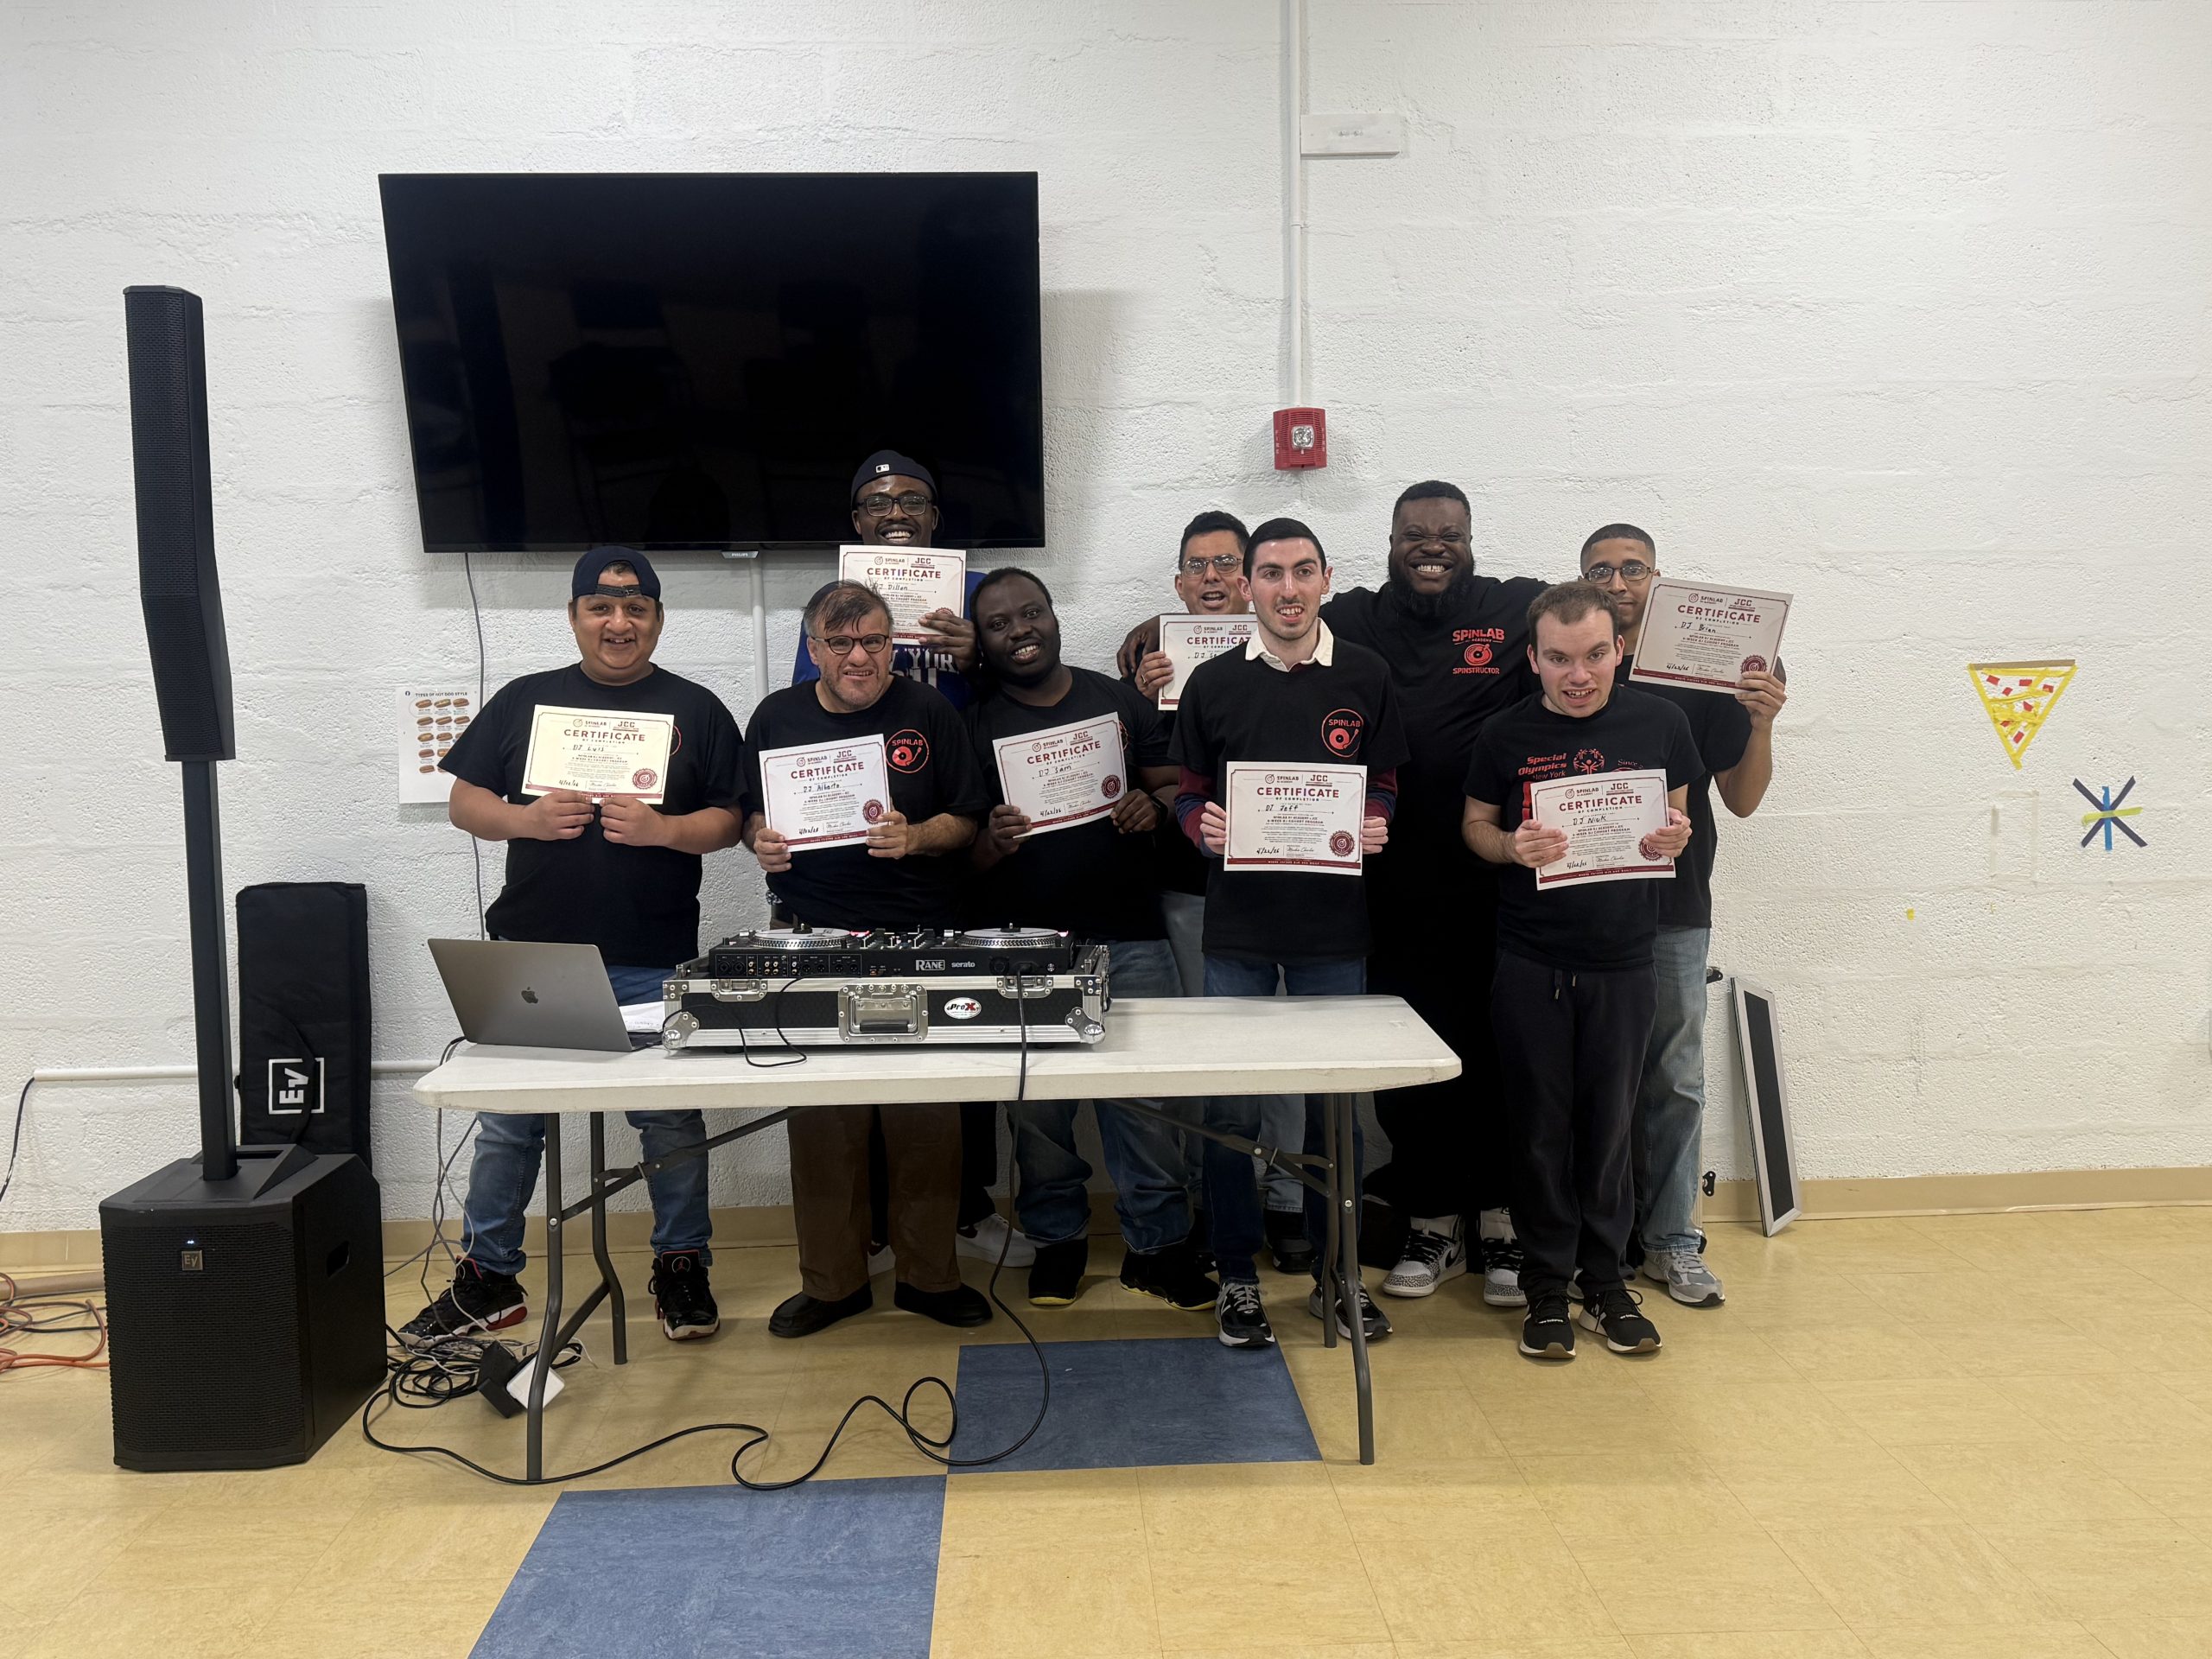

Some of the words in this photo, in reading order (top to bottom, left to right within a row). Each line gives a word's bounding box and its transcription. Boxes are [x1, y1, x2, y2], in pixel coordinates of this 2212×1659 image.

[867, 568, 941, 579] CERTIFICATE
[1734, 598, 1752, 607] JCC
[1677, 605, 1761, 623] CERTIFICATE
[1452, 628, 1505, 642] SPINLAB
[1328, 719, 1361, 728] SPINLAB
[563, 728, 645, 741] CERTIFICATE
[1073, 730, 1089, 740] JCC
[892, 738, 924, 747] SPINLAB
[1027, 741, 1101, 765] CERTIFICATE
[1527, 753, 1567, 765] Special
[791, 761, 864, 779] CERTIFICATE
[1517, 762, 1567, 776] Olympics
[1549, 770, 1566, 779] York
[1256, 787, 1339, 798] CERTIFICATE
[1611, 782, 1629, 791] JCC
[1559, 795, 1643, 811] CERTIFICATE
[916, 959, 944, 971] RANE
[950, 1002, 976, 1011] ProX
[279, 1067, 309, 1104] EV
[184, 1255, 199, 1268] EV
